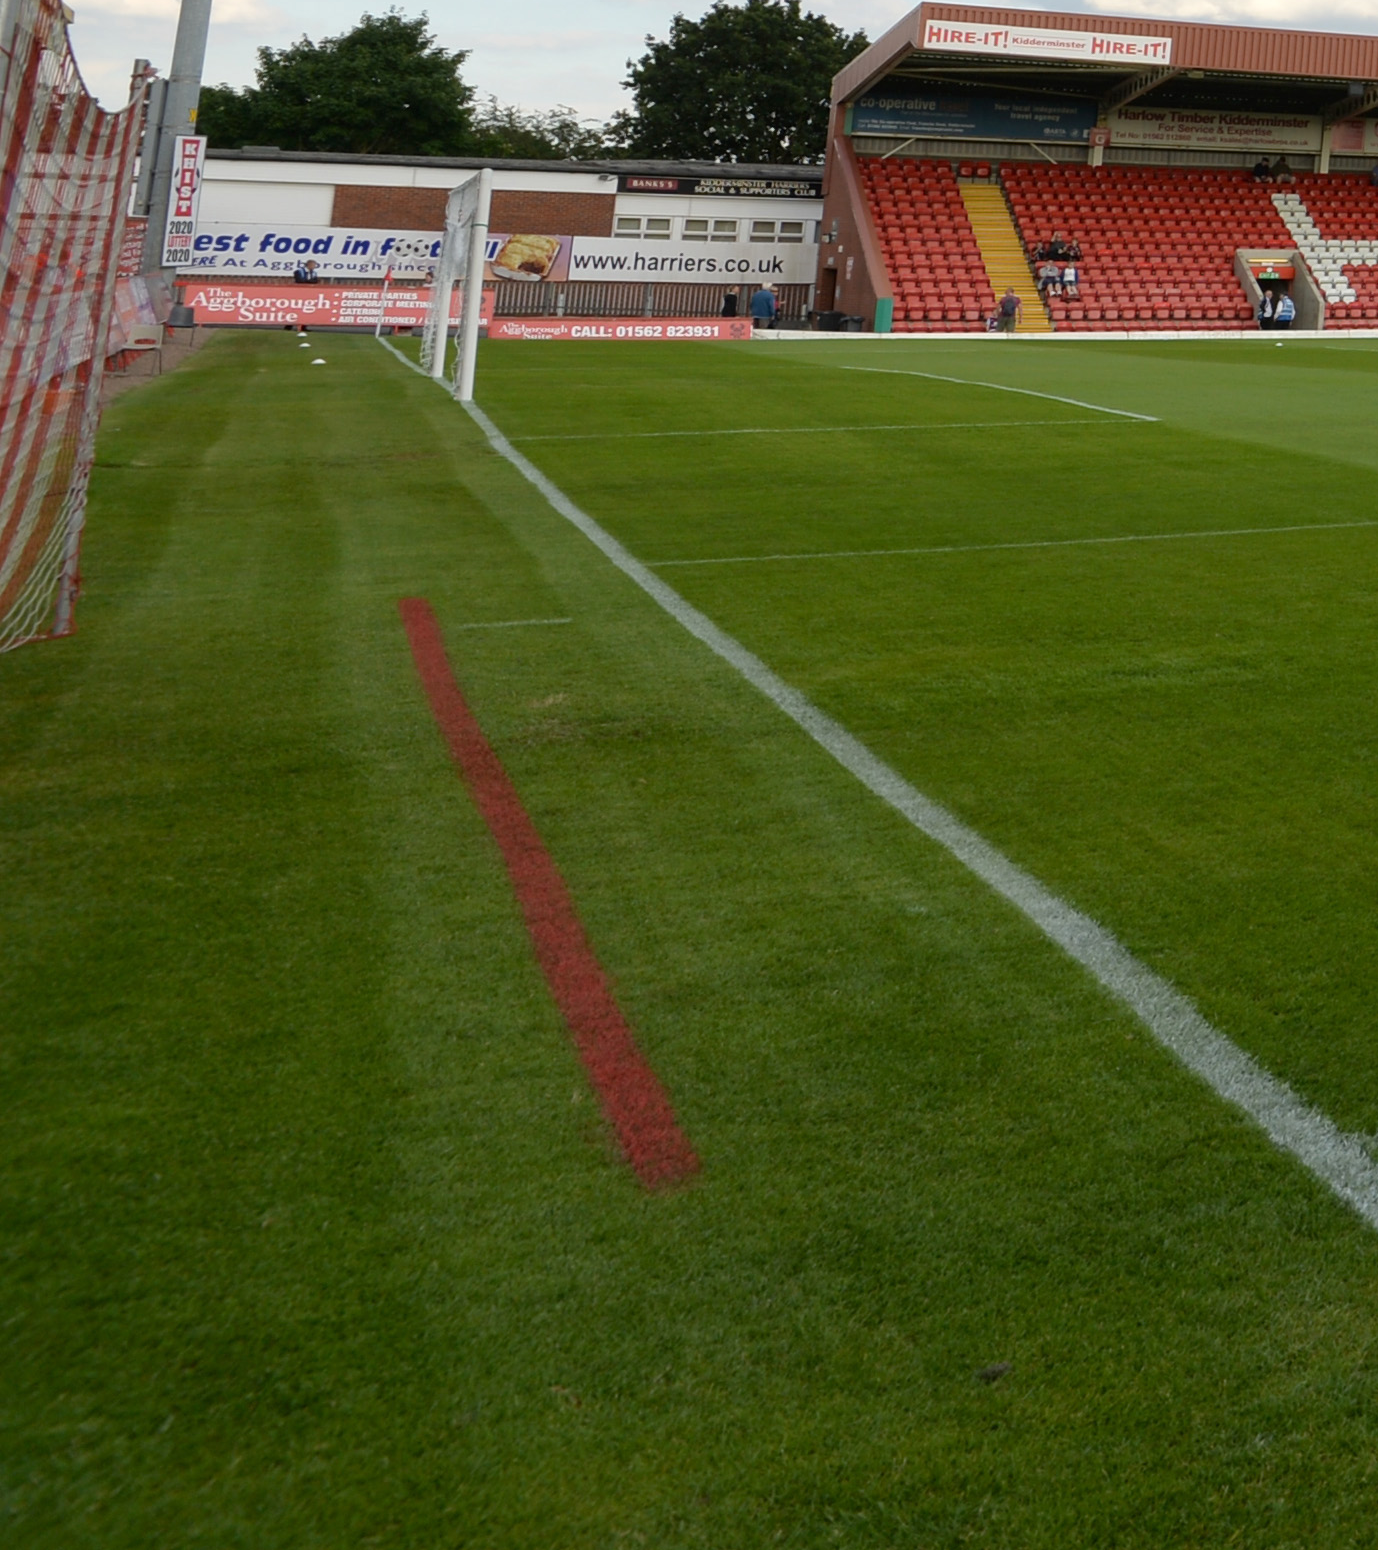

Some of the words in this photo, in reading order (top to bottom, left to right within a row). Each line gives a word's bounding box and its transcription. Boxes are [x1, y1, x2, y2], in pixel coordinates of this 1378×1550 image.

[927, 25, 1009, 49] HIRE-IT!
[1012, 37, 1086, 49] Kidderminster
[1091, 36, 1167, 59] HIRE-IT!
[1118, 109, 1165, 121] Harlow
[1170, 112, 1215, 124] Timber
[1219, 114, 1309, 128] Kidderminster
[1158, 123, 1175, 131] For
[1178, 124, 1214, 134] Service
[1217, 126, 1224, 134] &
[1227, 127, 1272, 137] Expertise
[1095, 134, 1105, 145] G
[632, 179, 673, 188] BANKS'S
[700, 179, 767, 189] KIDDERMINSTER
[771, 181, 810, 190] HARRIERS
[694, 186, 725, 194] SOCIAL
[740, 187, 791, 195] SUPPORTERS
[794, 188, 816, 196] CLUB
[169, 221, 193, 234] 2020
[193, 233, 250, 252] est
[259, 233, 334, 255] food
[341, 235, 371, 256] in
[380, 237, 499, 260] footll
[165, 249, 190, 262] 2020
[192, 255, 218, 266] ERE
[222, 258, 248, 267] At
[573, 252, 784, 274] www.harriers.co.uk
[208, 288, 232, 297] The
[190, 292, 330, 313] Aggborough
[238, 306, 298, 322] Suite
[499, 324, 568, 335] Aggborough
[522, 331, 552, 339] Suite
[571, 325, 612, 337] CALL:
[616, 325, 663, 338] 01562
[666, 326, 719, 338] 823931
